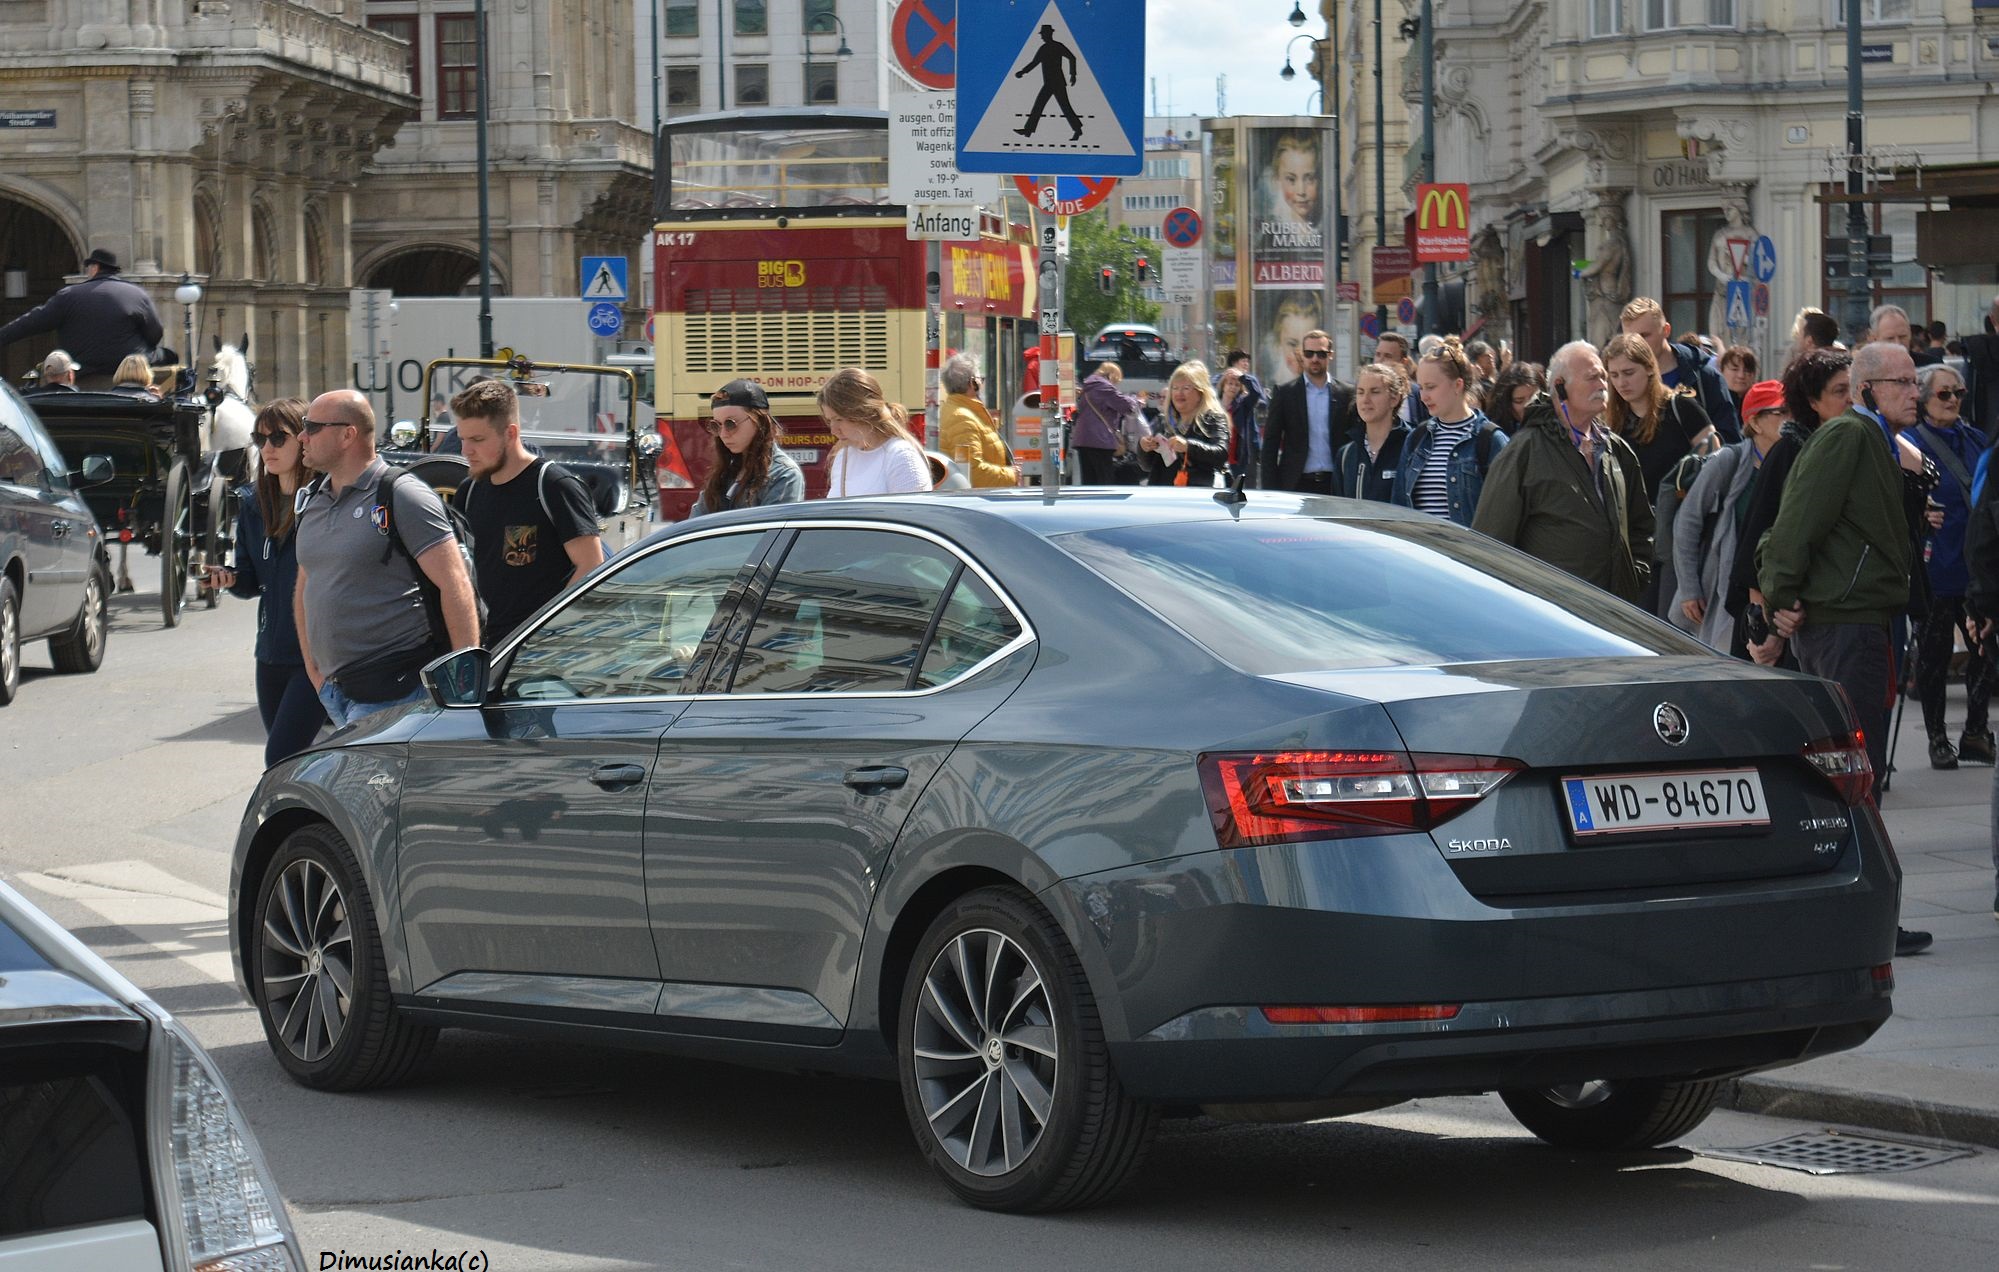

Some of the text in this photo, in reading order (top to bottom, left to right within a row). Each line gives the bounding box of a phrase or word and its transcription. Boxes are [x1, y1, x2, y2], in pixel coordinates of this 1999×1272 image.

[899, 114, 935, 125] ausgen.
[911, 126, 927, 137] mit
[914, 187, 973, 200] ausgen. Taxi
[914, 212, 971, 237] Anfang
[1261, 221, 1313, 235] RUBENS
[656, 233, 695, 246] AK 17
[1272, 234, 1323, 247] MAKART
[758, 261, 784, 275] BIG
[758, 275, 784, 288] BUS
[1174, 294, 1193, 303] Ende
[737, 377, 829, 387] P-ON HOP-O
[1594, 778, 1757, 822] WD-84670
[1579, 812, 1588, 824] A
[1800, 817, 1848, 831] SUPERB
[1448, 838, 1513, 853] ŠKODA
